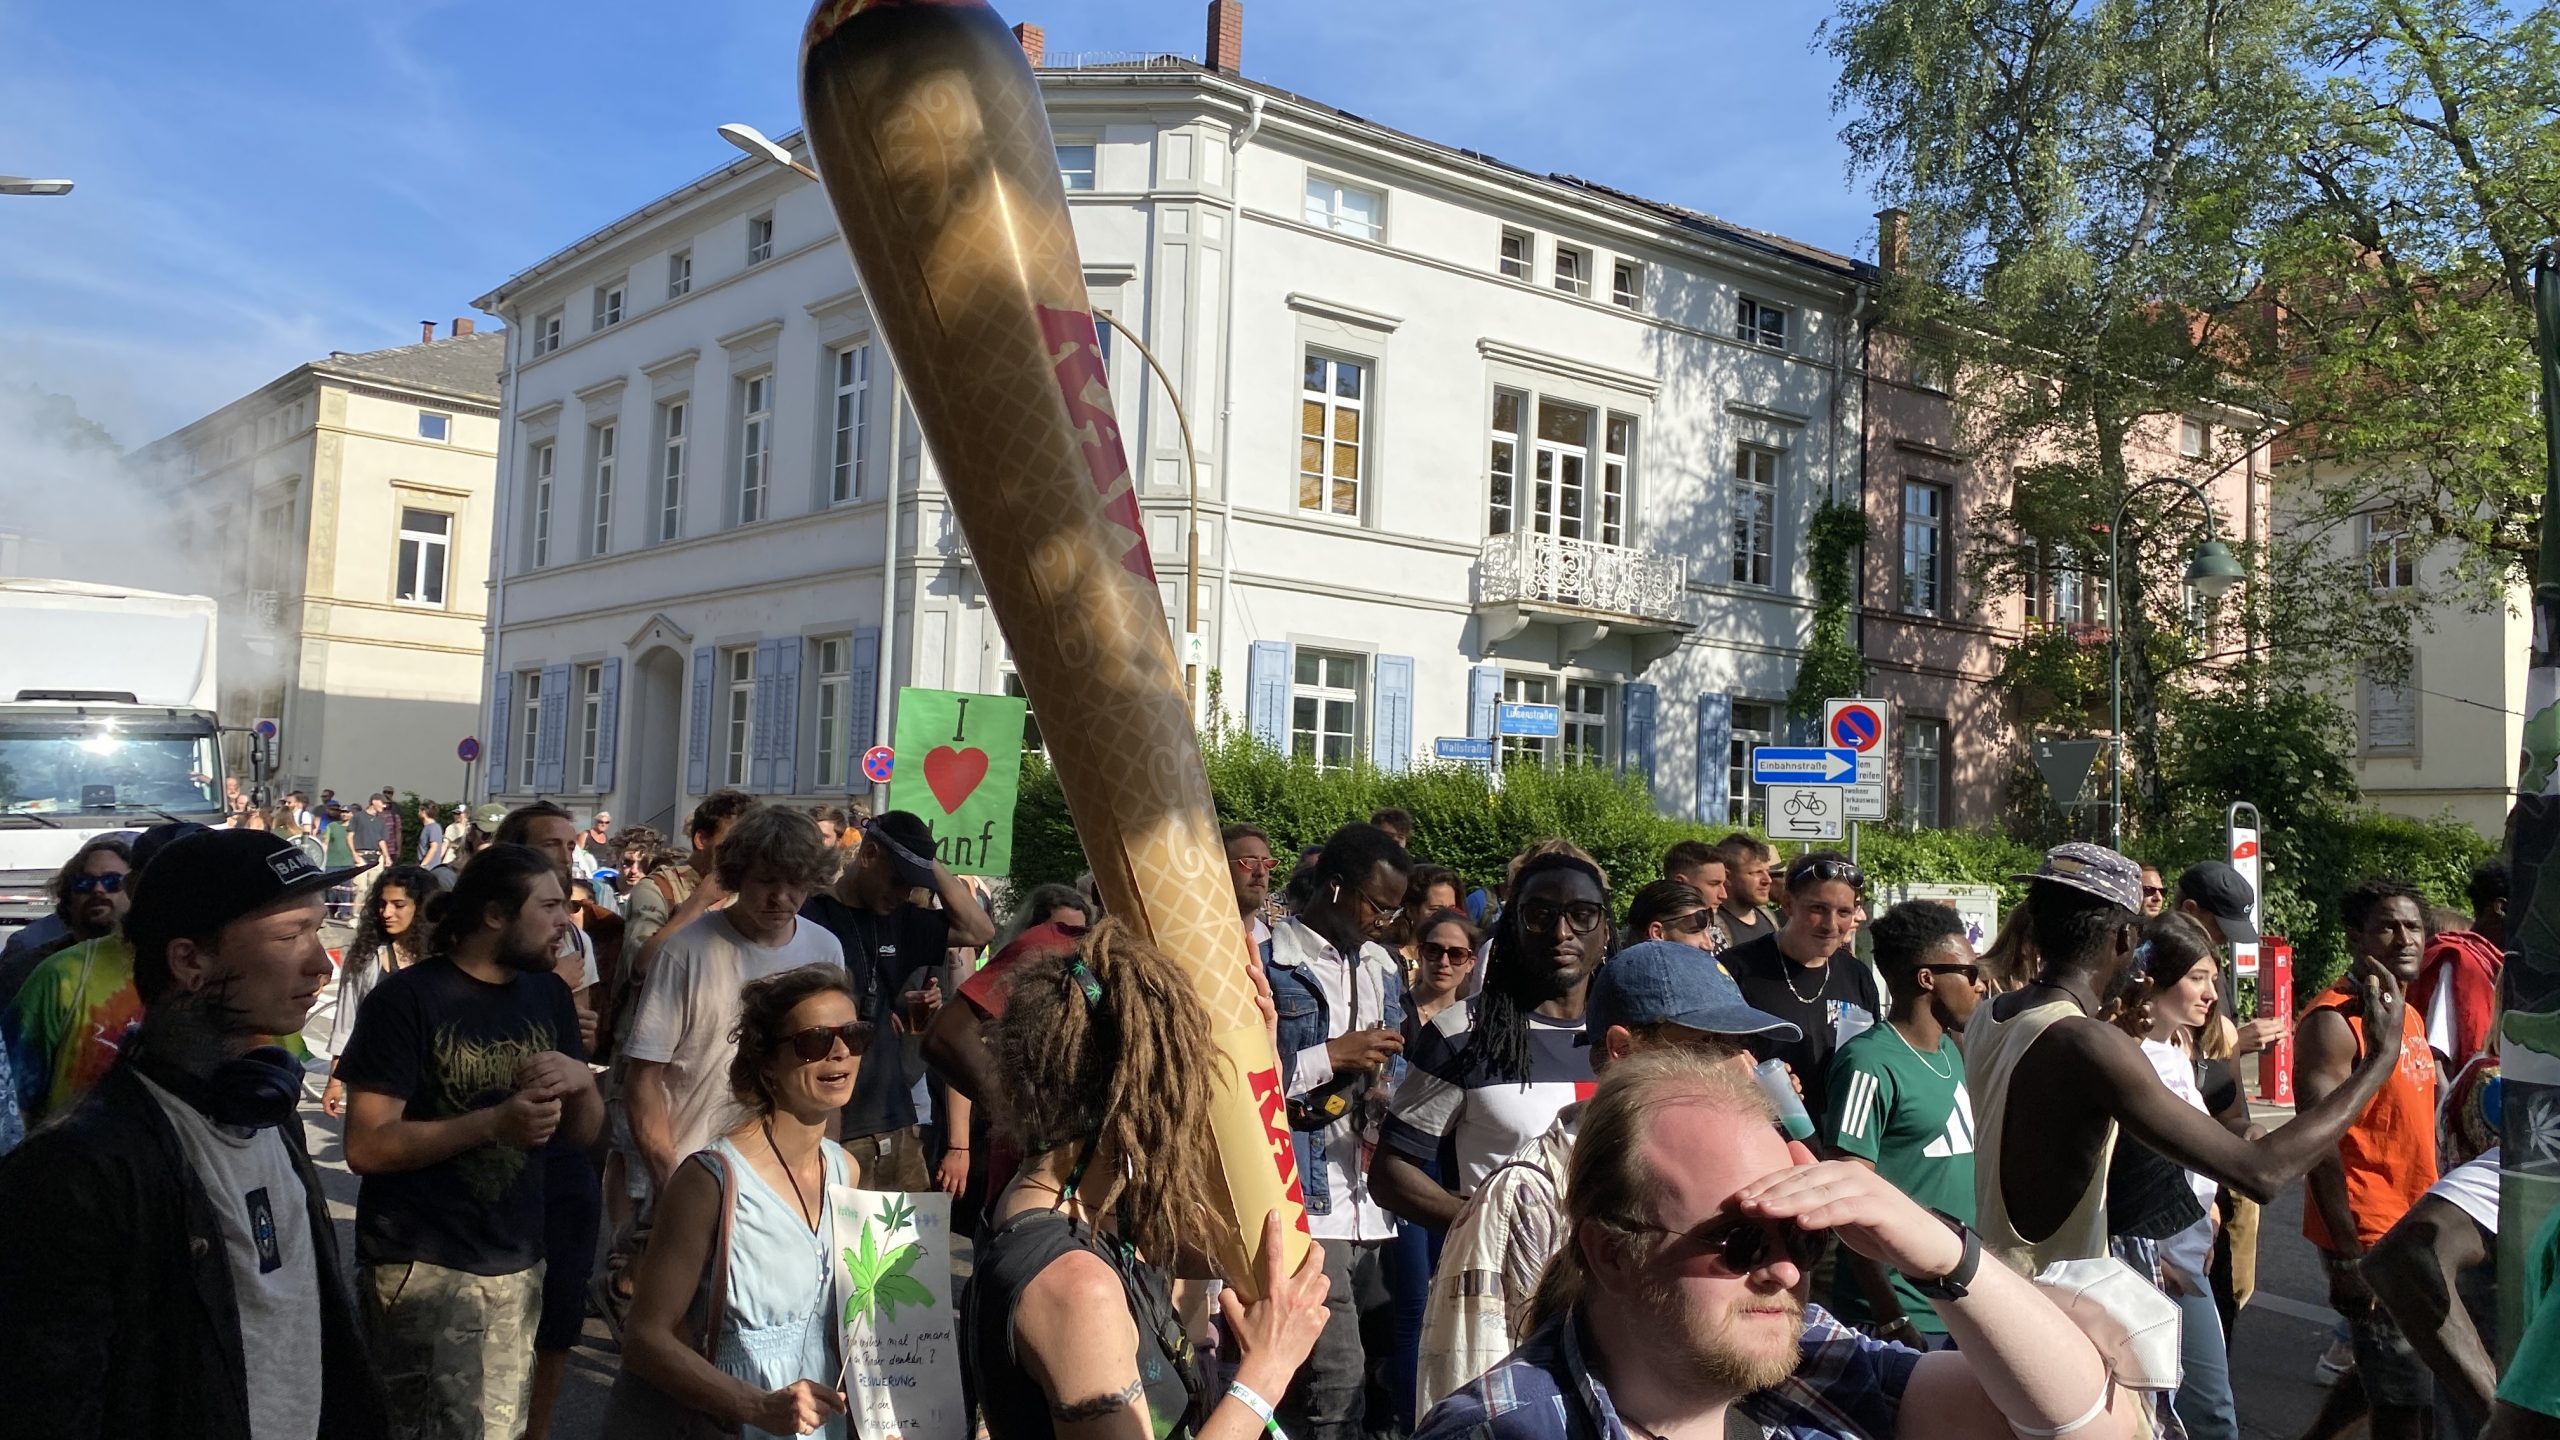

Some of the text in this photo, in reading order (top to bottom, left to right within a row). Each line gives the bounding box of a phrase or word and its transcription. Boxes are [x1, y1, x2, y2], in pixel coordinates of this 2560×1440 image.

[952, 697, 970, 742] I
[1442, 741, 1487, 754] Wallstraße
[1759, 760, 1828, 771] Einbahnstraße
[1859, 771, 1881, 780] reifen
[1844, 796, 1880, 804] arkausweis
[928, 819, 996, 869] anf
